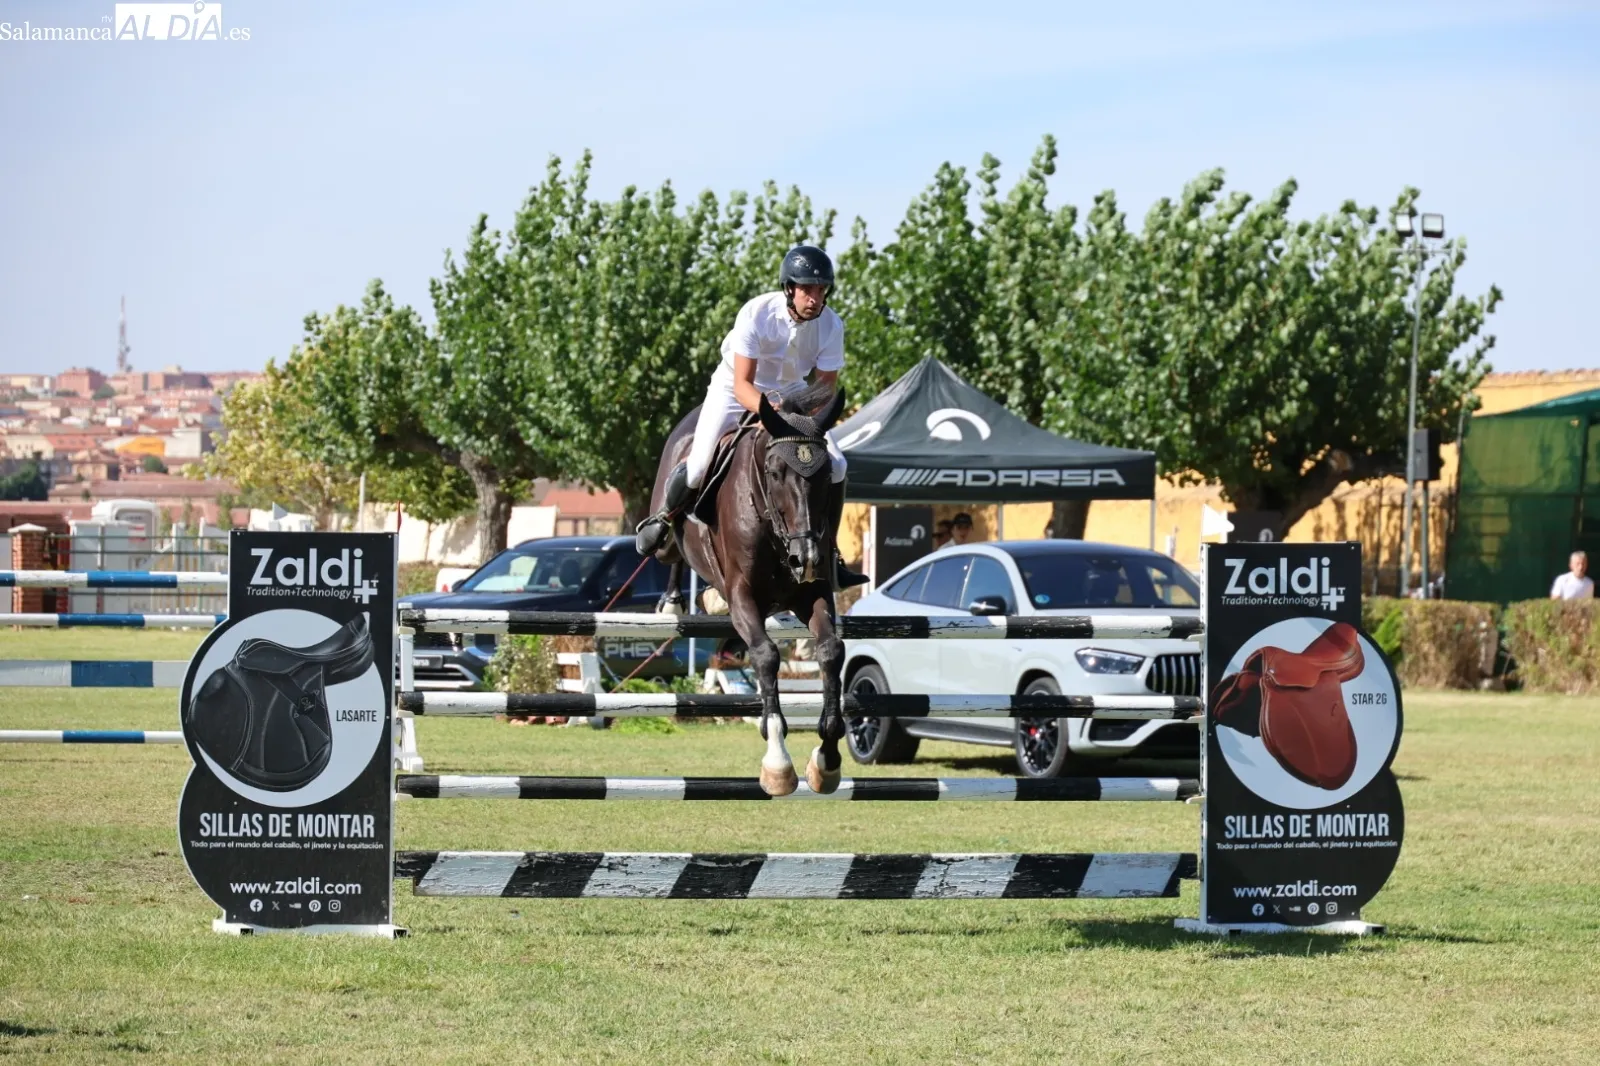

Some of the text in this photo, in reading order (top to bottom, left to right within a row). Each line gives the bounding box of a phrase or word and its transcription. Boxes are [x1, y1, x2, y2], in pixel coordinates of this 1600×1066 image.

[929, 468, 1125, 486] ADARSA
[250, 548, 363, 586] Zaldi
[1224, 557, 1330, 594] Zaldi
[1352, 693, 1388, 705] STAR 2G
[336, 710, 377, 722] LASARTE
[200, 813, 374, 838] SILLAS DE MONTAR
[1225, 814, 1389, 839] SILLAS DE MONTAR
[311, 842, 331, 850] jinete
[230, 877, 362, 894] www.zaldi.com
[1233, 880, 1357, 897] www.zaldi.com
